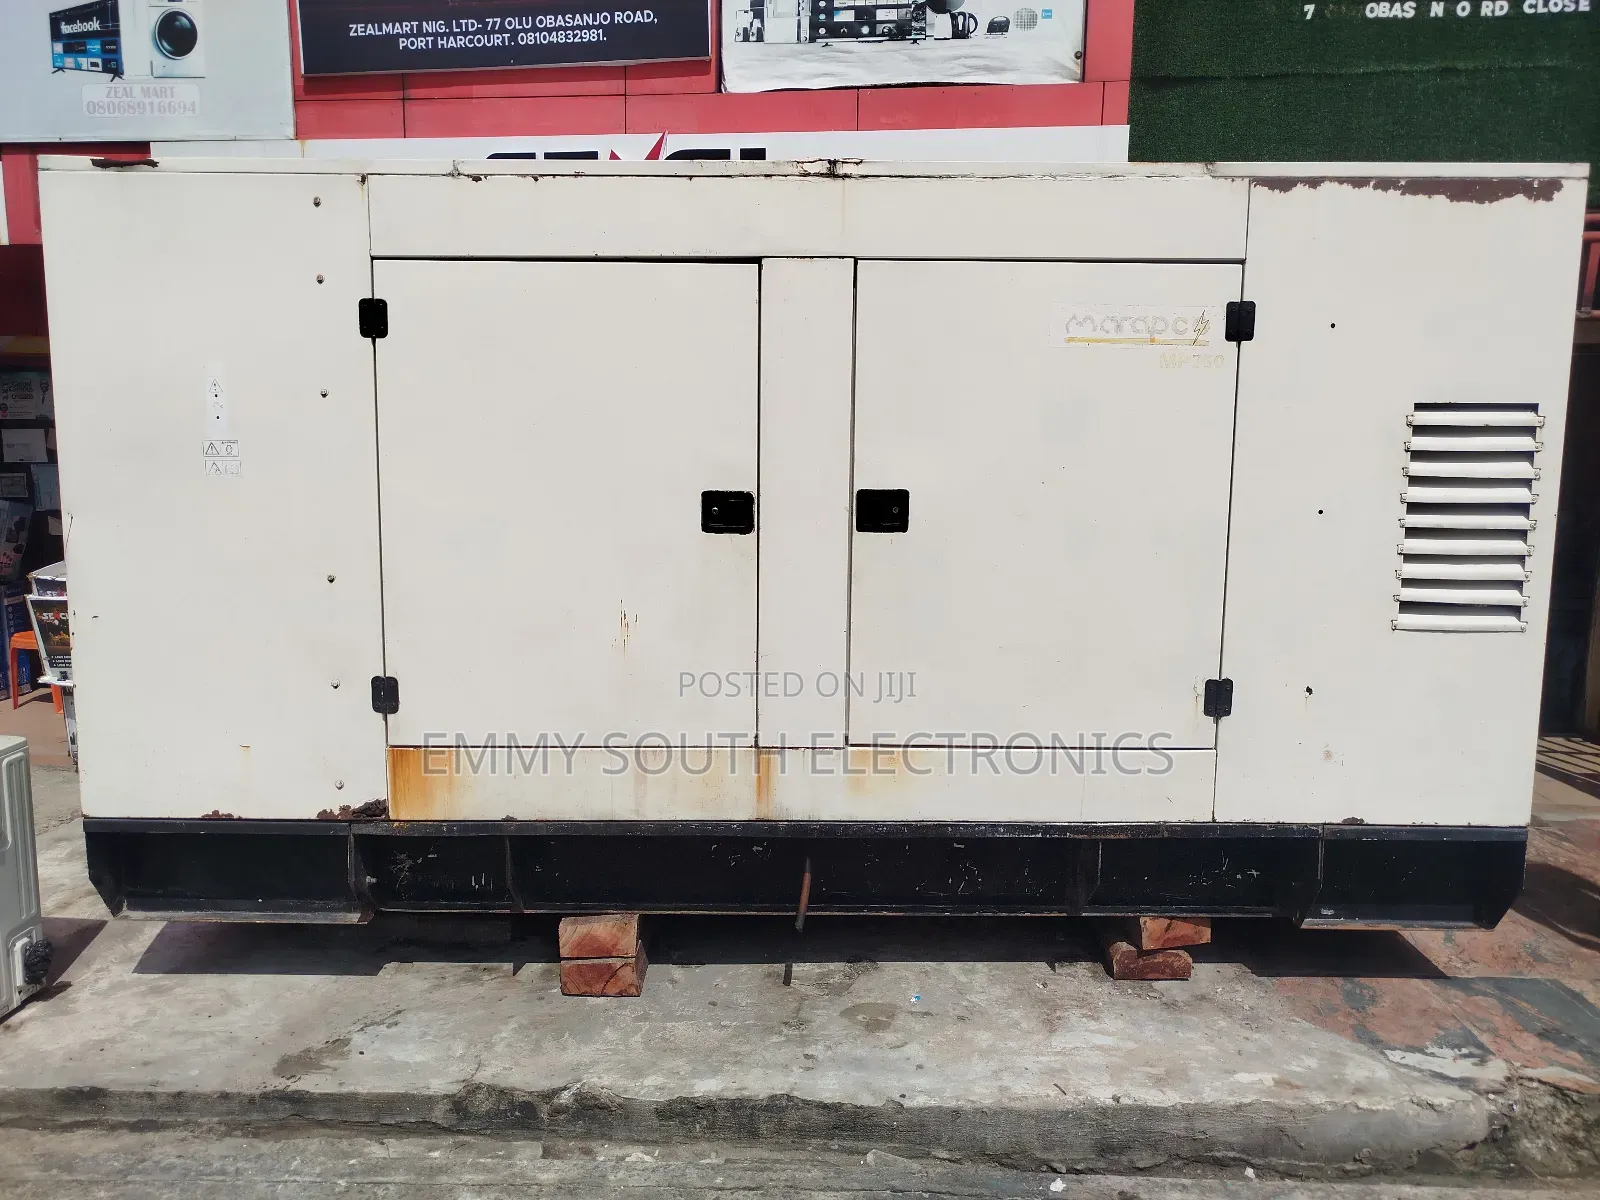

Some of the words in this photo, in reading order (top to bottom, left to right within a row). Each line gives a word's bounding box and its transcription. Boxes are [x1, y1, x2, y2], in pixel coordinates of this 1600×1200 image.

[1303, 4, 1316, 20] 7
[1480, 0, 1509, 17] RD
[1522, 0, 1591, 14] CLOSE
[61, 16, 101, 34] facebook
[349, 21, 419, 37] ZEALMART
[422, 20, 450, 33] NIG.
[452, 18, 483, 32] LTD-
[485, 17, 502, 31] 77
[504, 15, 533, 30] OLU
[535, 12, 611, 29] OBASANJO
[614, 9, 658, 24] ROAD,
[399, 36, 434, 50] PORT
[437, 32, 515, 49] HARCOURT.
[517, 28, 607, 46] 08104832981.
[105, 86, 136, 99] ZEAL
[140, 86, 175, 99] MART
[86, 100, 196, 115] 08068916694
